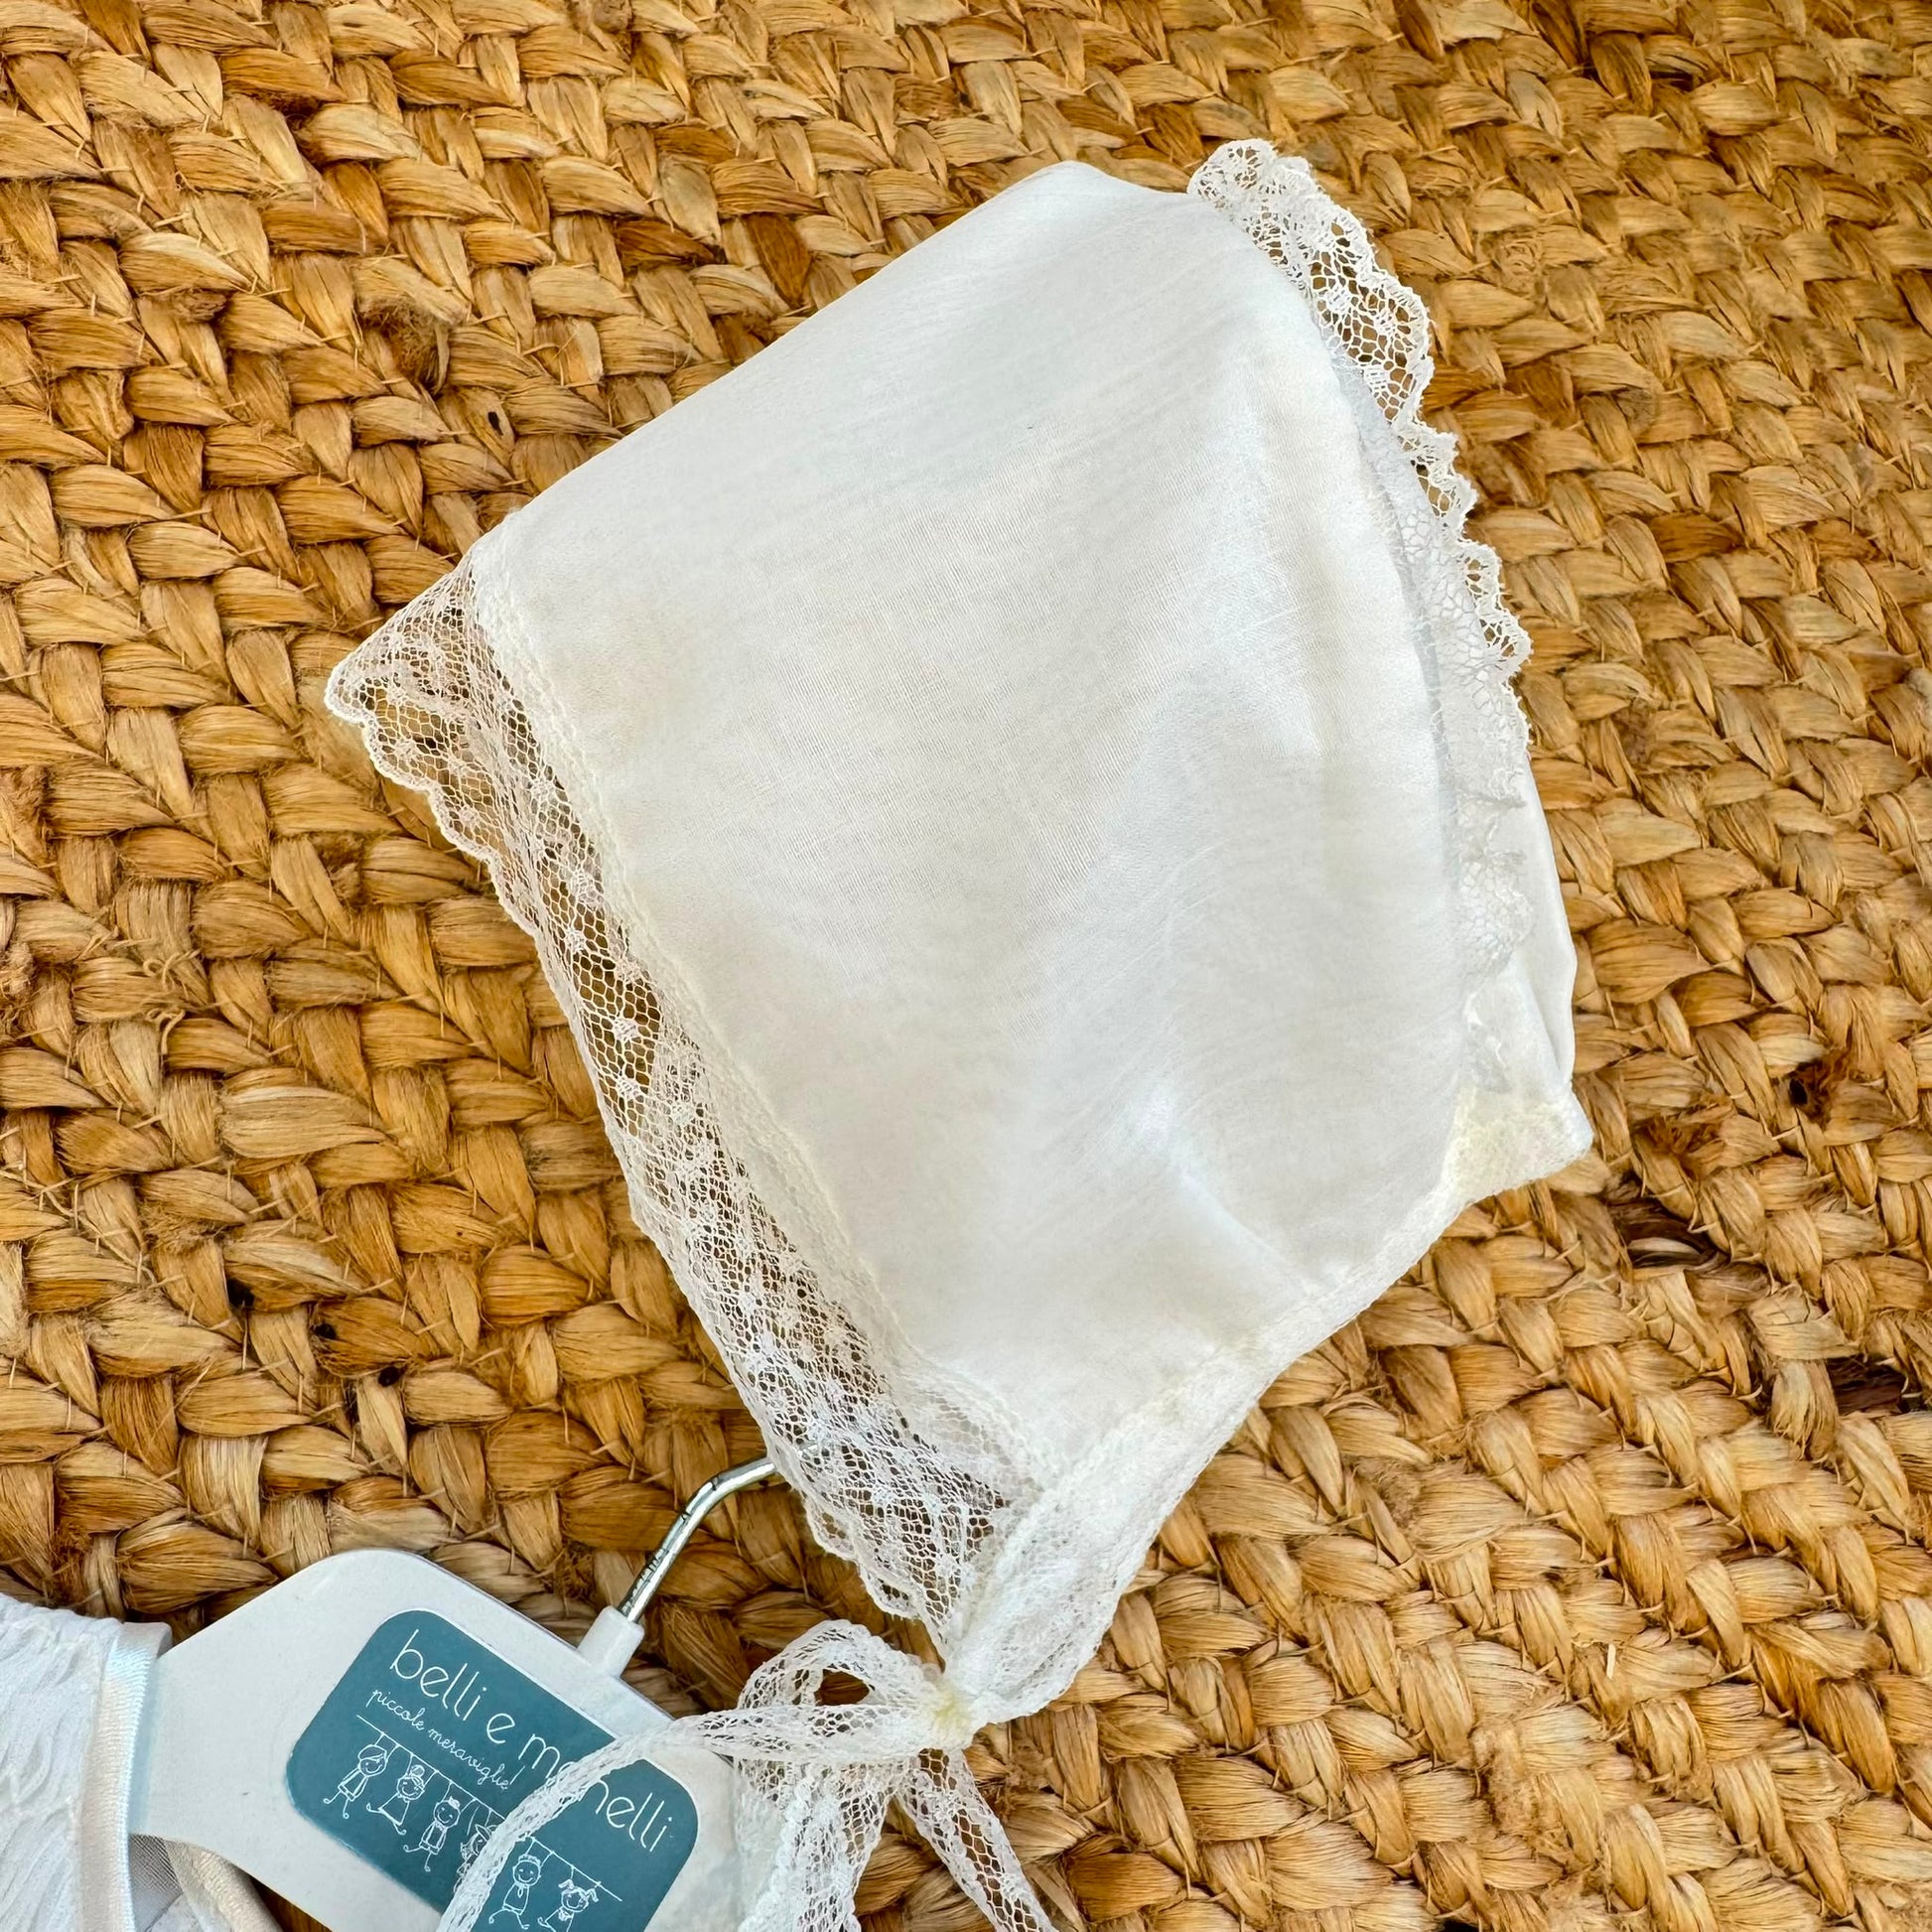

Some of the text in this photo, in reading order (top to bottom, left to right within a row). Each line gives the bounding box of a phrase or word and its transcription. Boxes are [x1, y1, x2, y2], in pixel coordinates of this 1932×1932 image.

[365, 1689, 426, 1731] piccole
[389, 1628, 673, 1853] belli e mnelli
